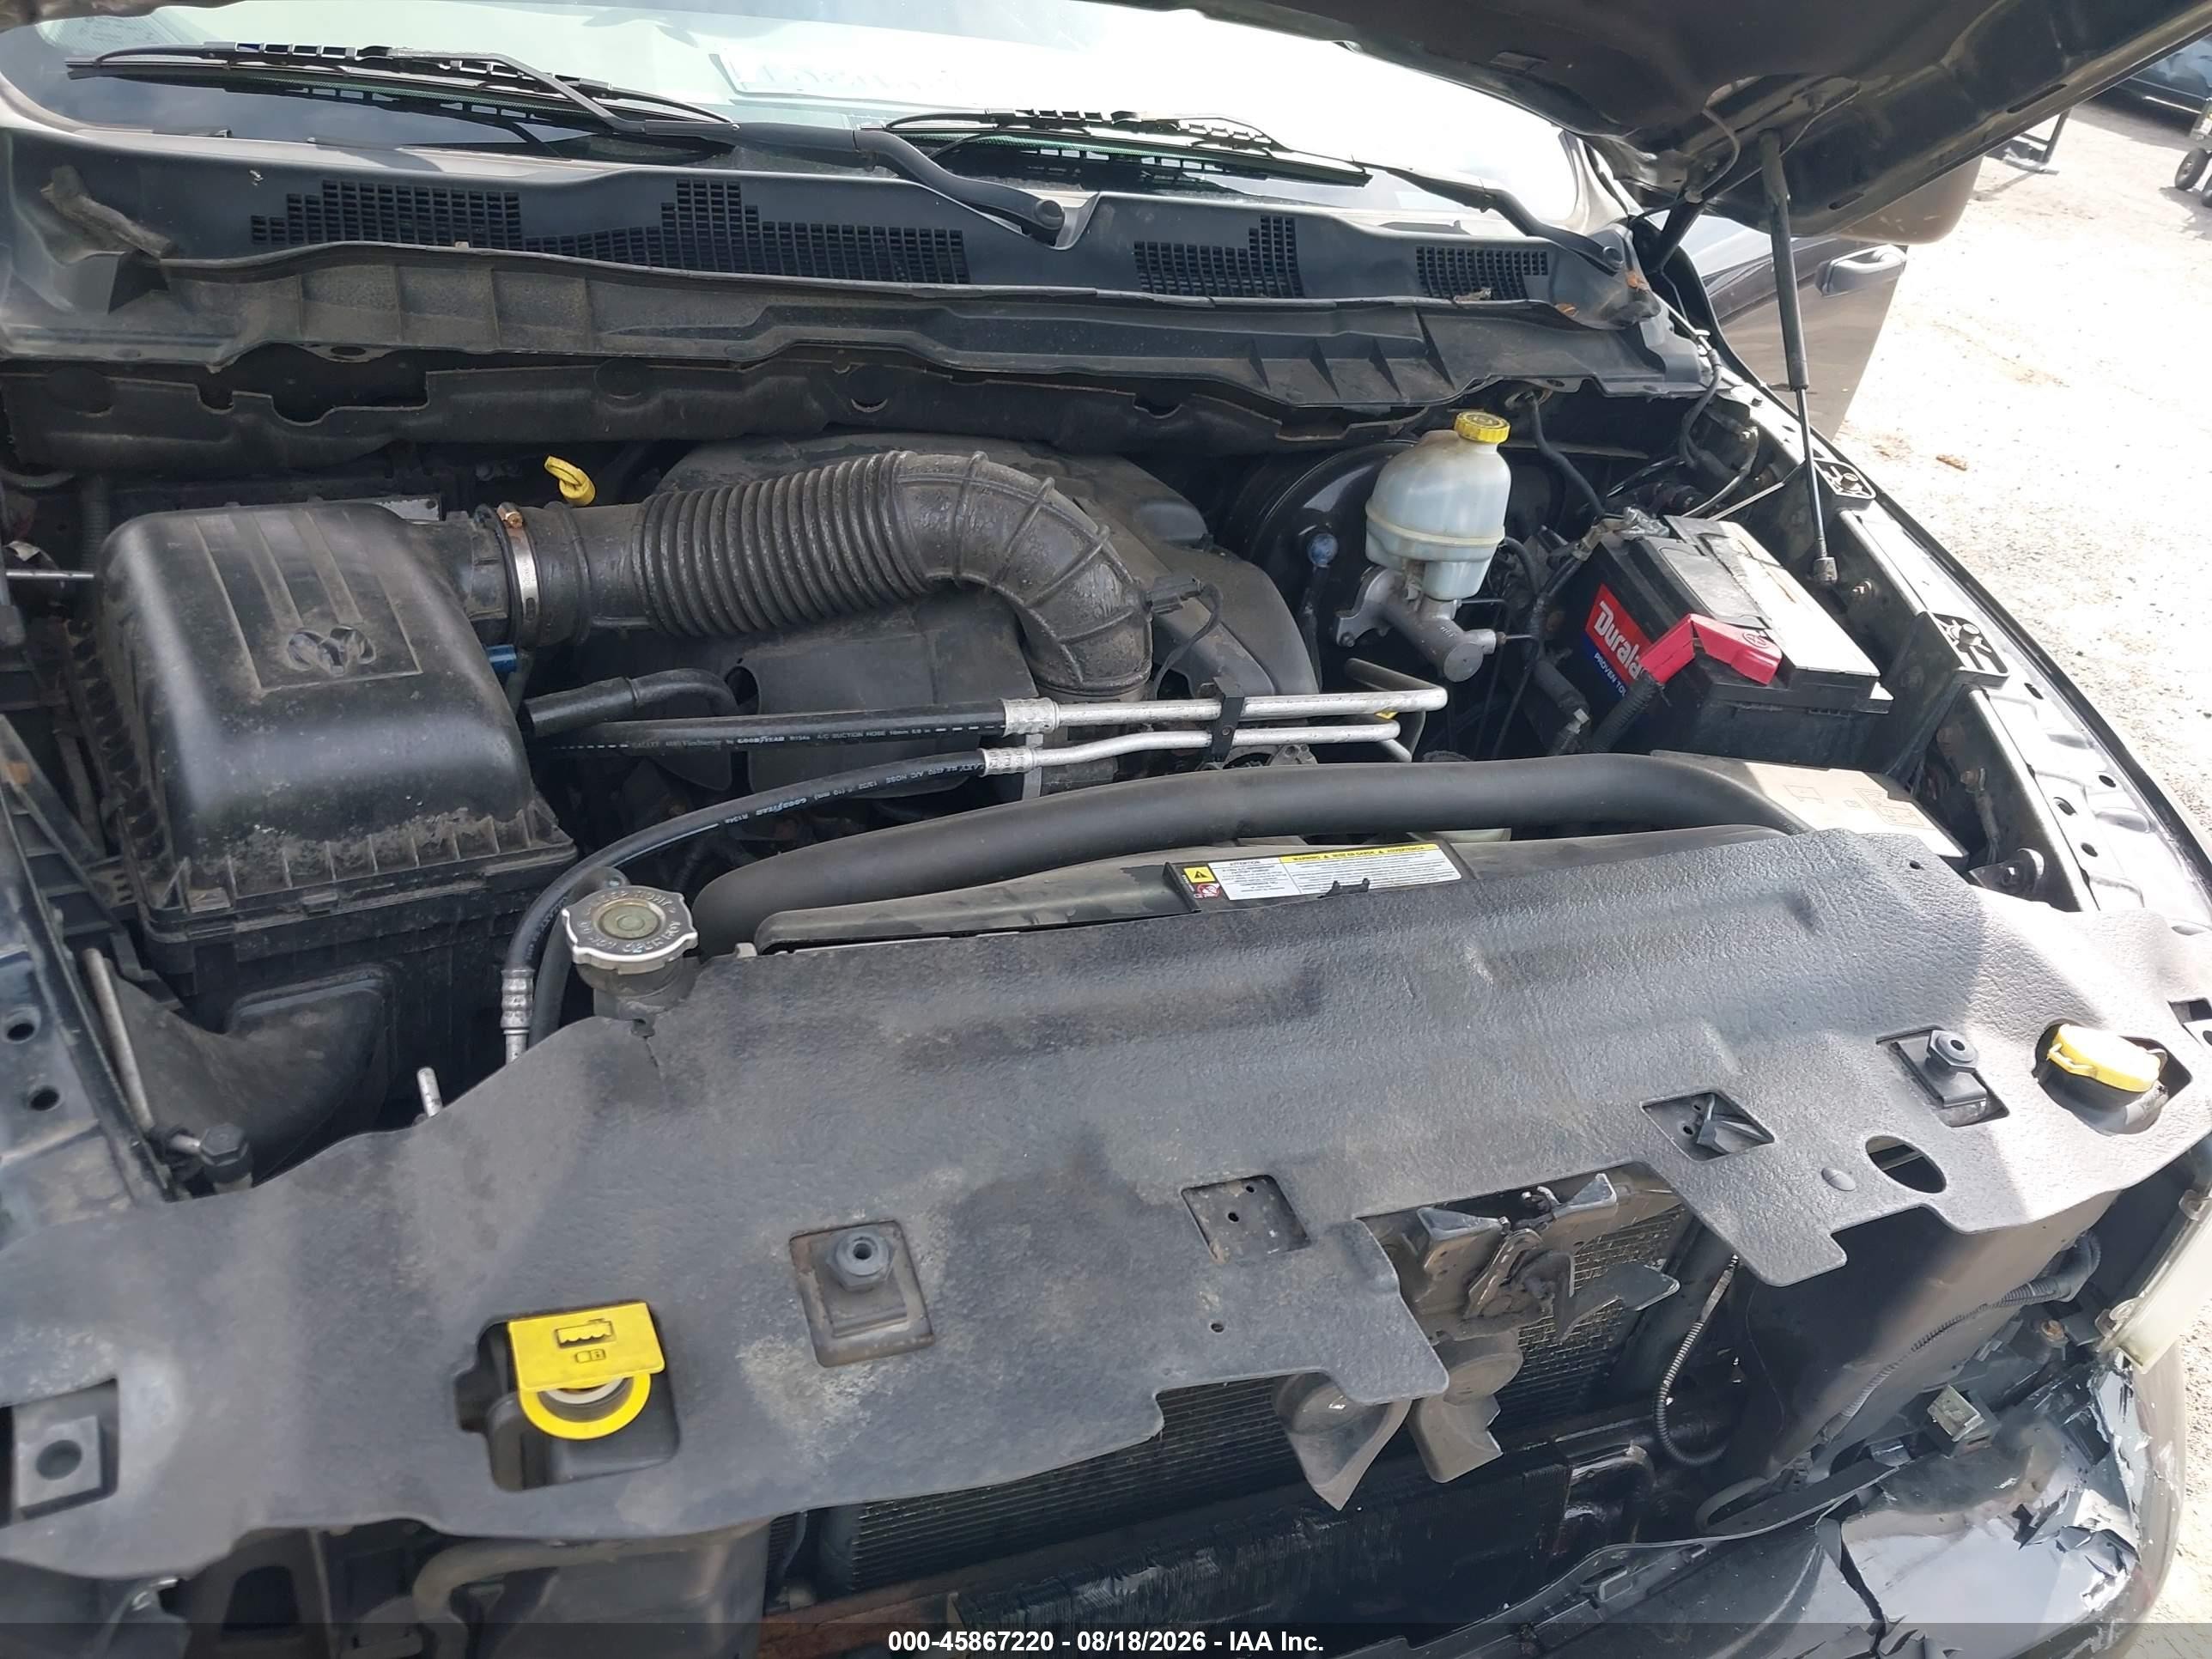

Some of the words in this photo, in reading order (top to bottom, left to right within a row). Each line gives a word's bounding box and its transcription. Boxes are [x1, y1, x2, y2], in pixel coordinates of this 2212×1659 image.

[1594, 601, 1646, 679] Durala
[1594, 653, 1618, 684] PROVEN
[737, 736, 785, 744] GOODYEAR
[755, 798, 807, 816] GOODYEAR
